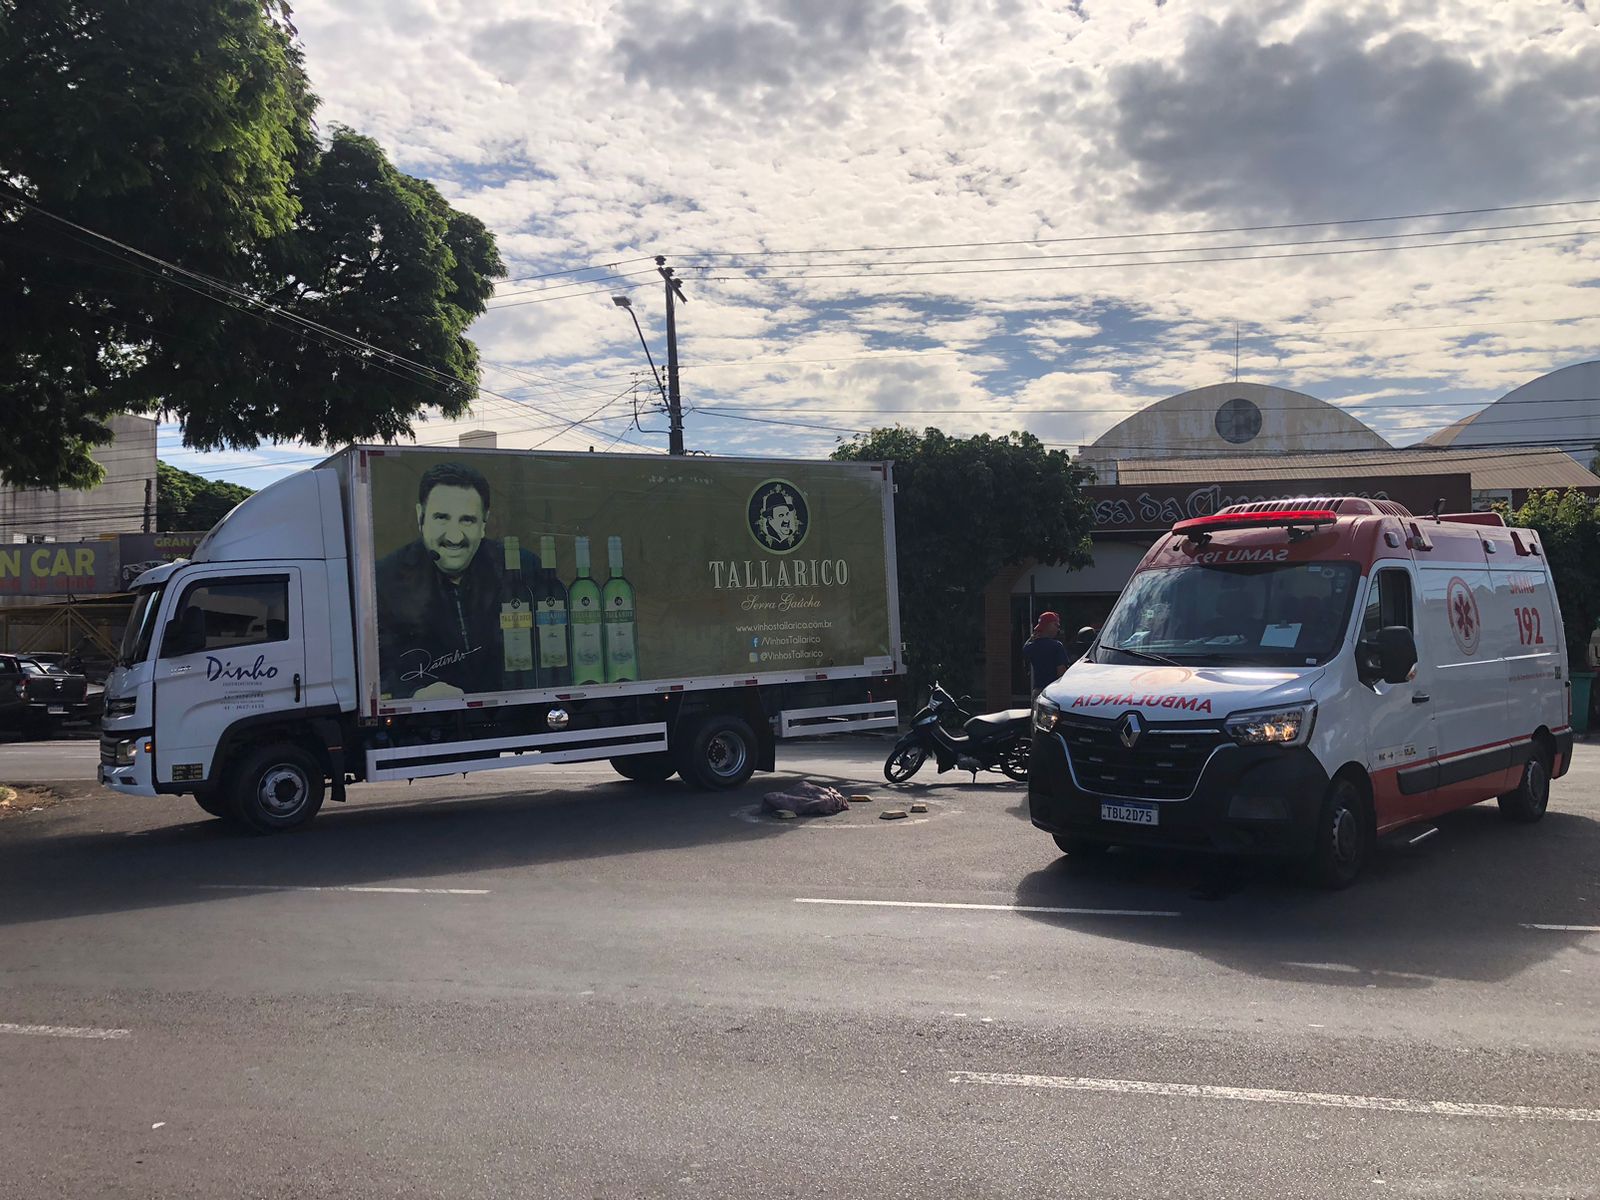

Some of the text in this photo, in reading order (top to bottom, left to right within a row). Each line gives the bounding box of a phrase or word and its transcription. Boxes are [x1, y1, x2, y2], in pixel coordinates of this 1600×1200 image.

[153, 537, 190, 547] GRAN
[30, 548, 96, 577] CAR
[709, 559, 848, 589] TALLARICO
[1506, 575, 1535, 595] SAMU
[741, 593, 822, 612] Serra Gaúcha
[736, 620, 832, 632] www.vinhostallarico.com.br
[1514, 607, 1544, 645] 192
[205, 654, 278, 682] Dinho
[1106, 806, 1152, 823] TBL2D75
